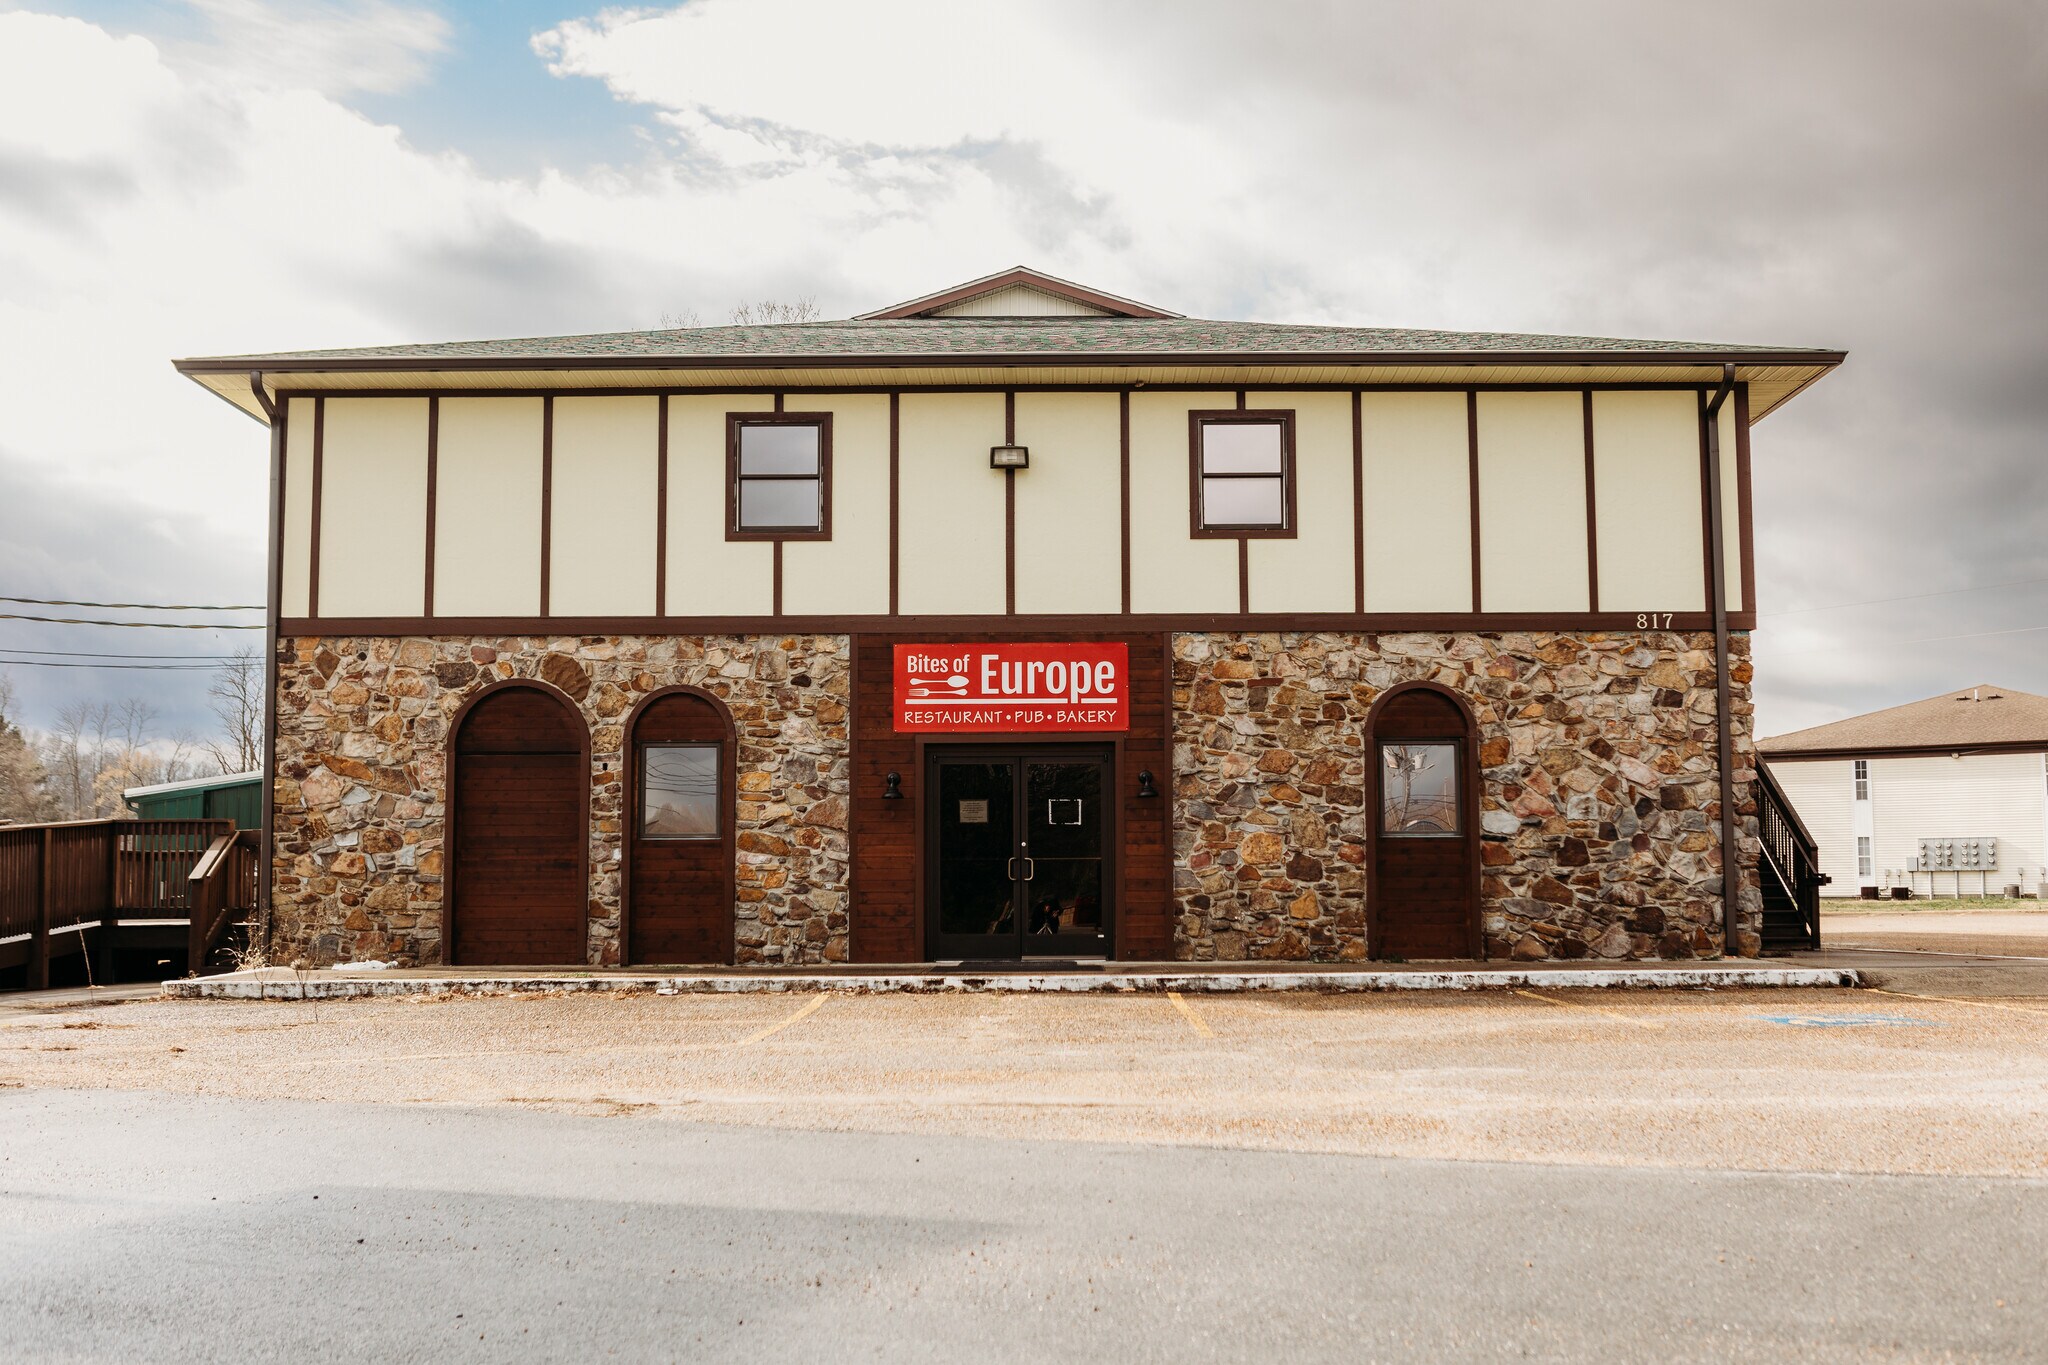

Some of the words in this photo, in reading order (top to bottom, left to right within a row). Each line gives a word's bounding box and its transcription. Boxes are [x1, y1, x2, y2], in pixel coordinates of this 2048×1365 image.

[1636, 613, 1673, 629] 817
[907, 654, 949, 673] Bites
[952, 654, 970, 673] of
[981, 654, 1115, 704] Europe
[904, 711, 1002, 724] RESTAURANT
[1014, 710, 1044, 724] PUB
[1056, 710, 1117, 723] BAKERY
